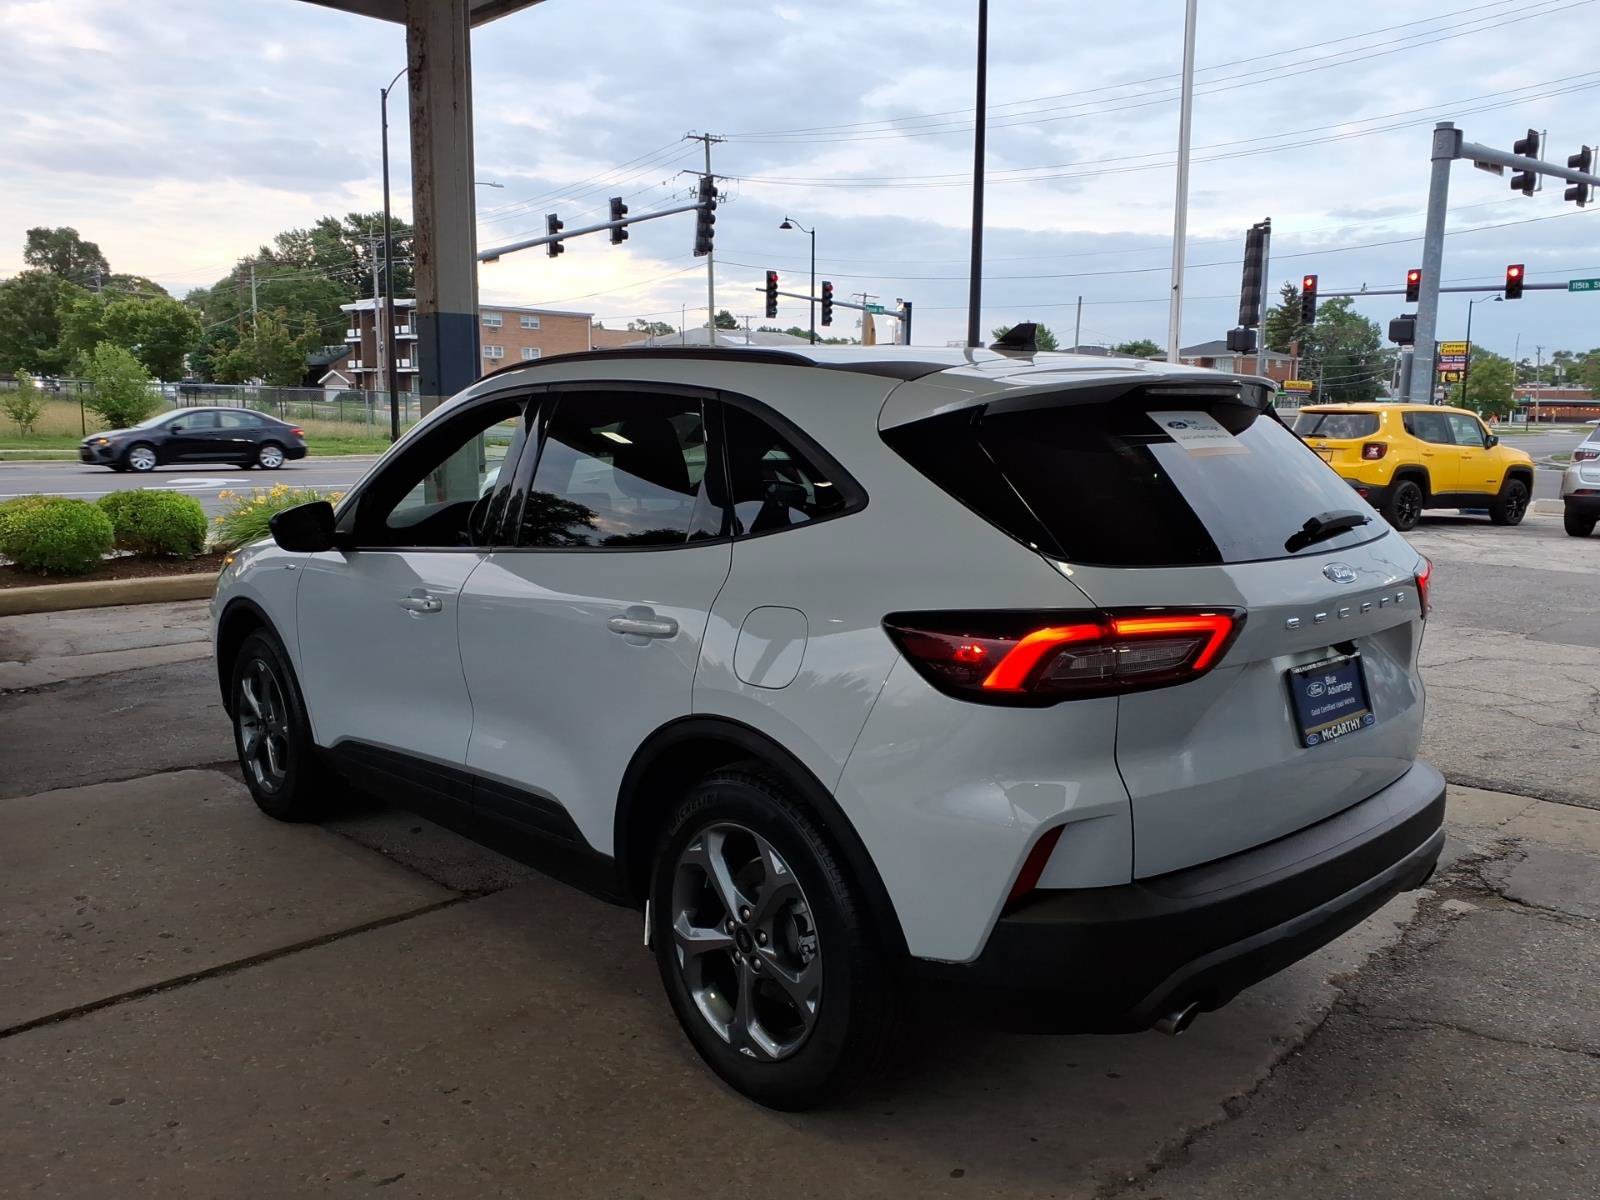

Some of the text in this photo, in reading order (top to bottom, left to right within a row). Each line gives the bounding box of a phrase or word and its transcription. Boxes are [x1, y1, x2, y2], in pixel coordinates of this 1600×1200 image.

[1285, 592, 1405, 630] ESCAPE
[1325, 676, 1337, 685] Blue
[1327, 681, 1353, 696] Advantage
[1321, 716, 1361, 741] McCARTHY
